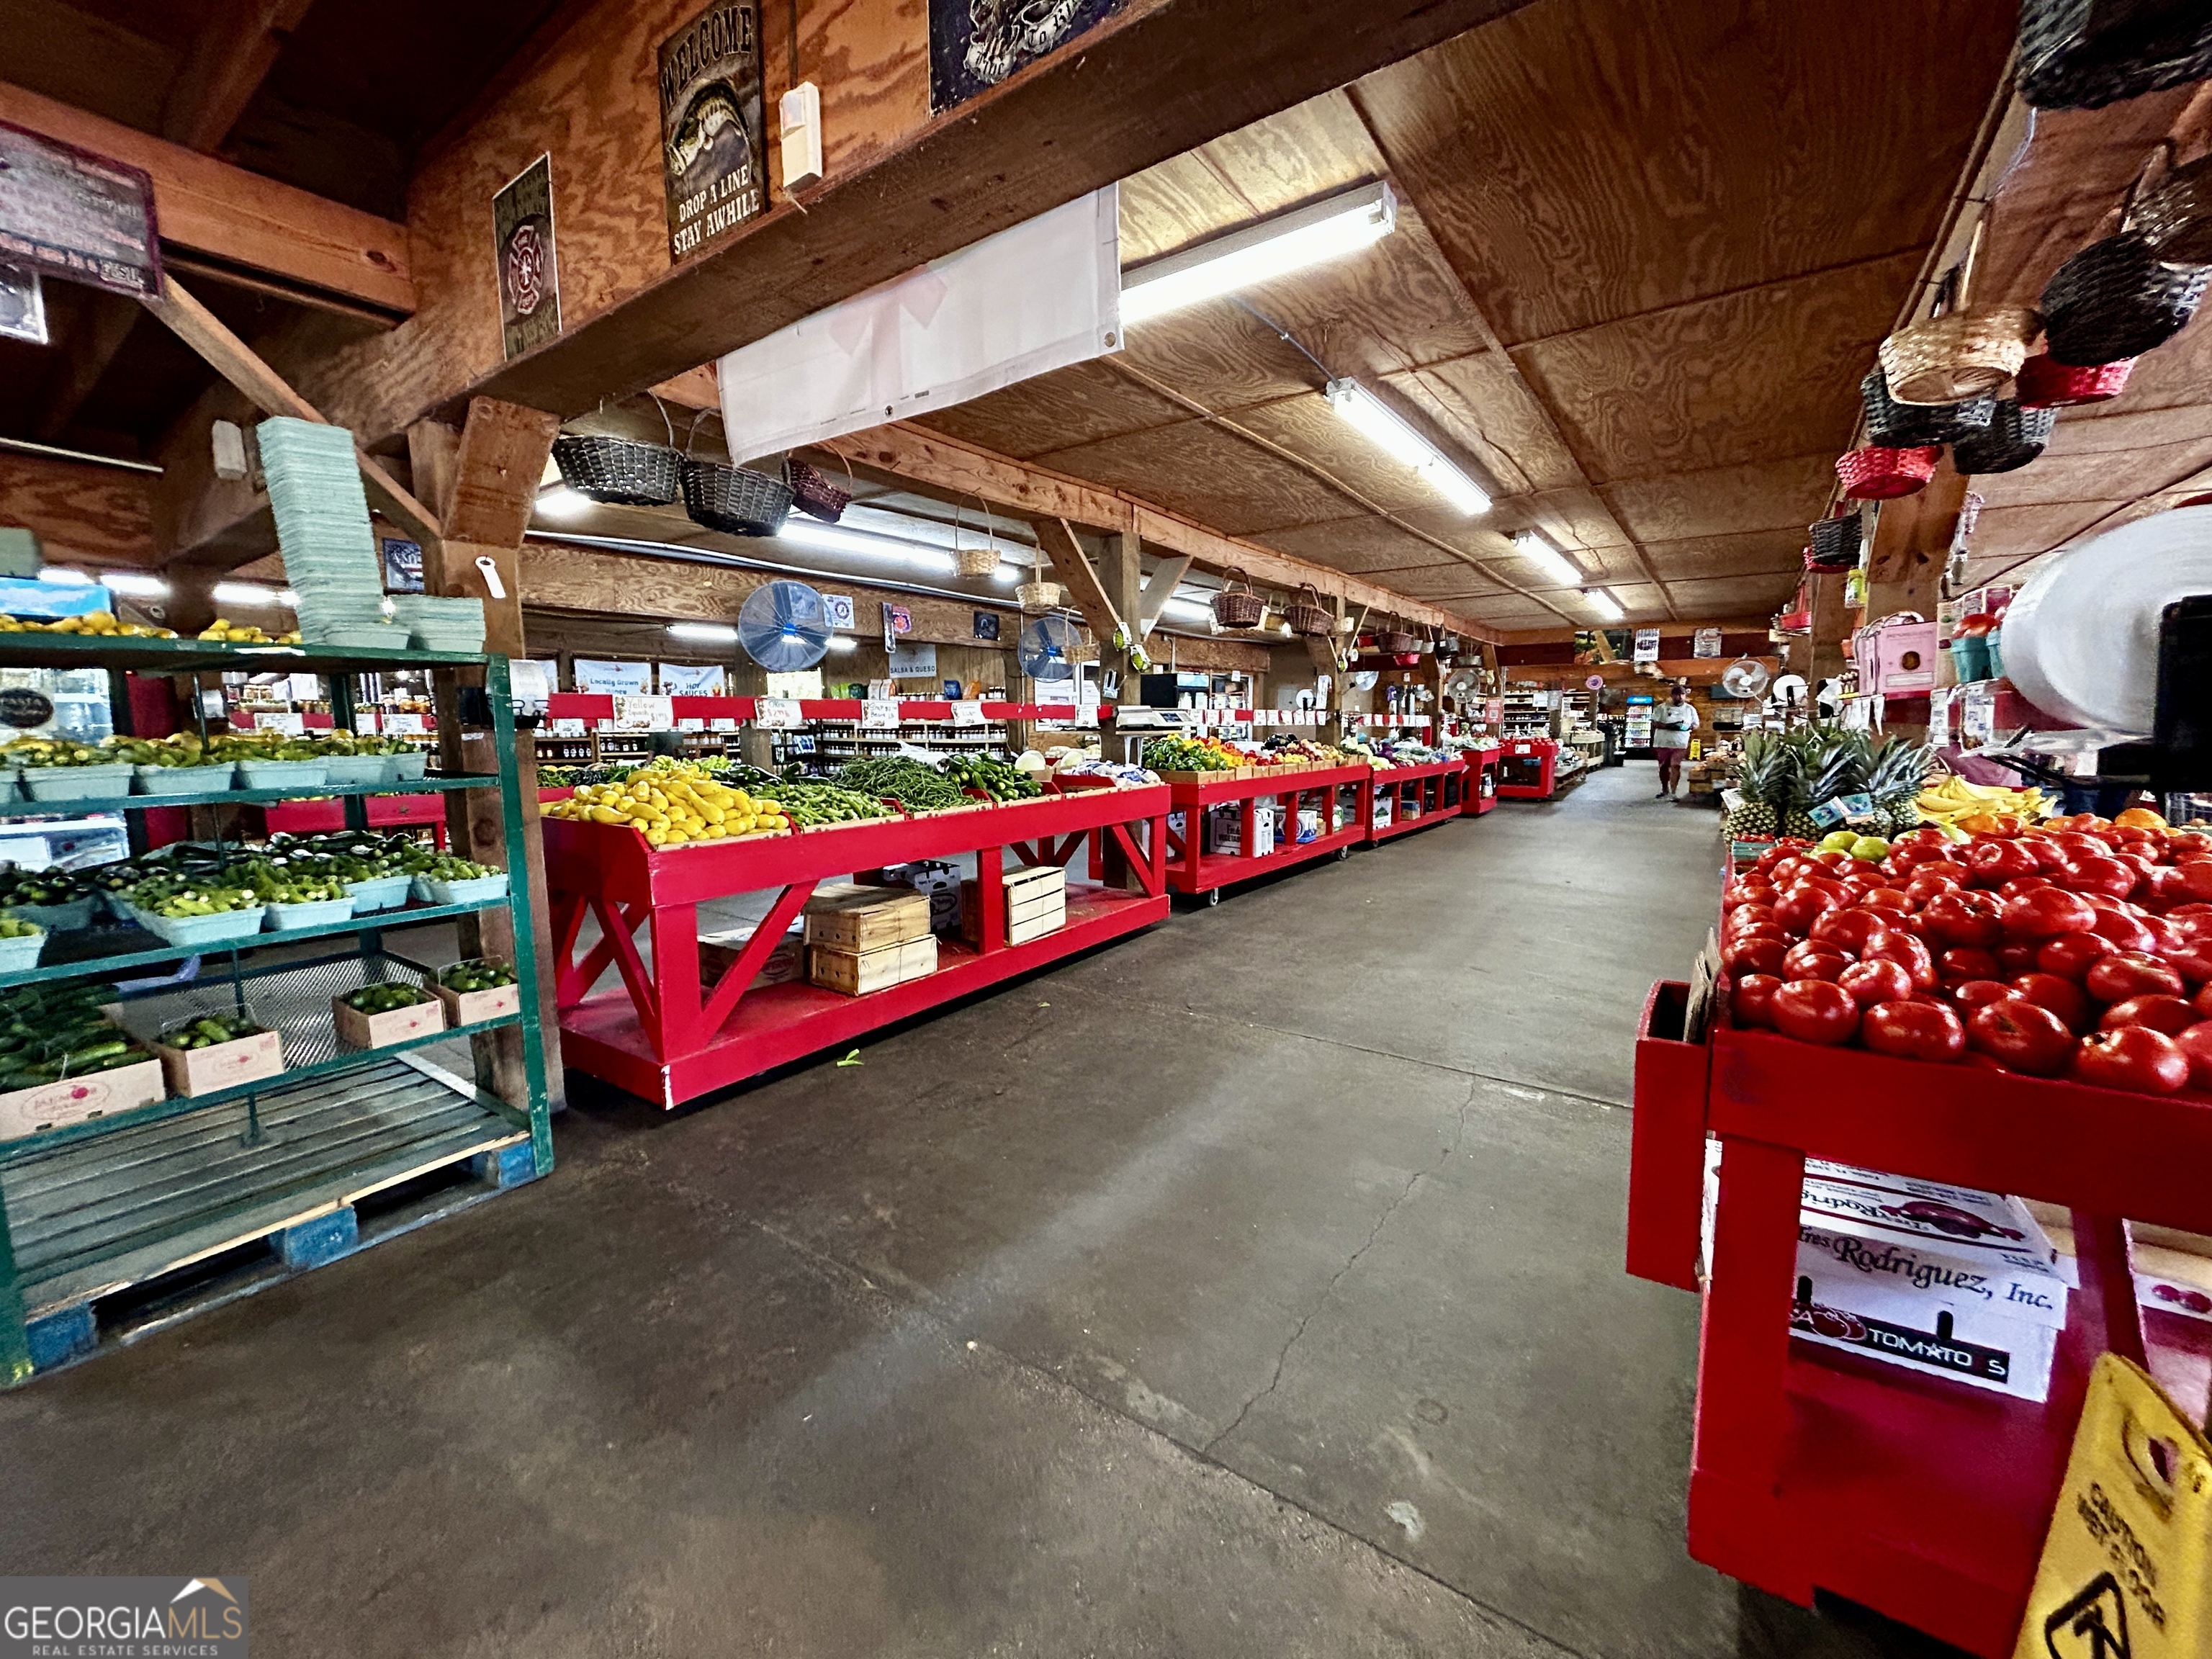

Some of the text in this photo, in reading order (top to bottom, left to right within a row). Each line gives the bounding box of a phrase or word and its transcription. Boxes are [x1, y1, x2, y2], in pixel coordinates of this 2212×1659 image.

[660, 4, 752, 114] WELCOME
[674, 188, 760, 256] STAY AWHILE
[678, 163, 749, 223] DROP A LINE
[590, 678, 616, 687] Locally
[626, 697, 655, 709] Yellow
[1834, 1235, 1993, 1299] Rodriguez,
